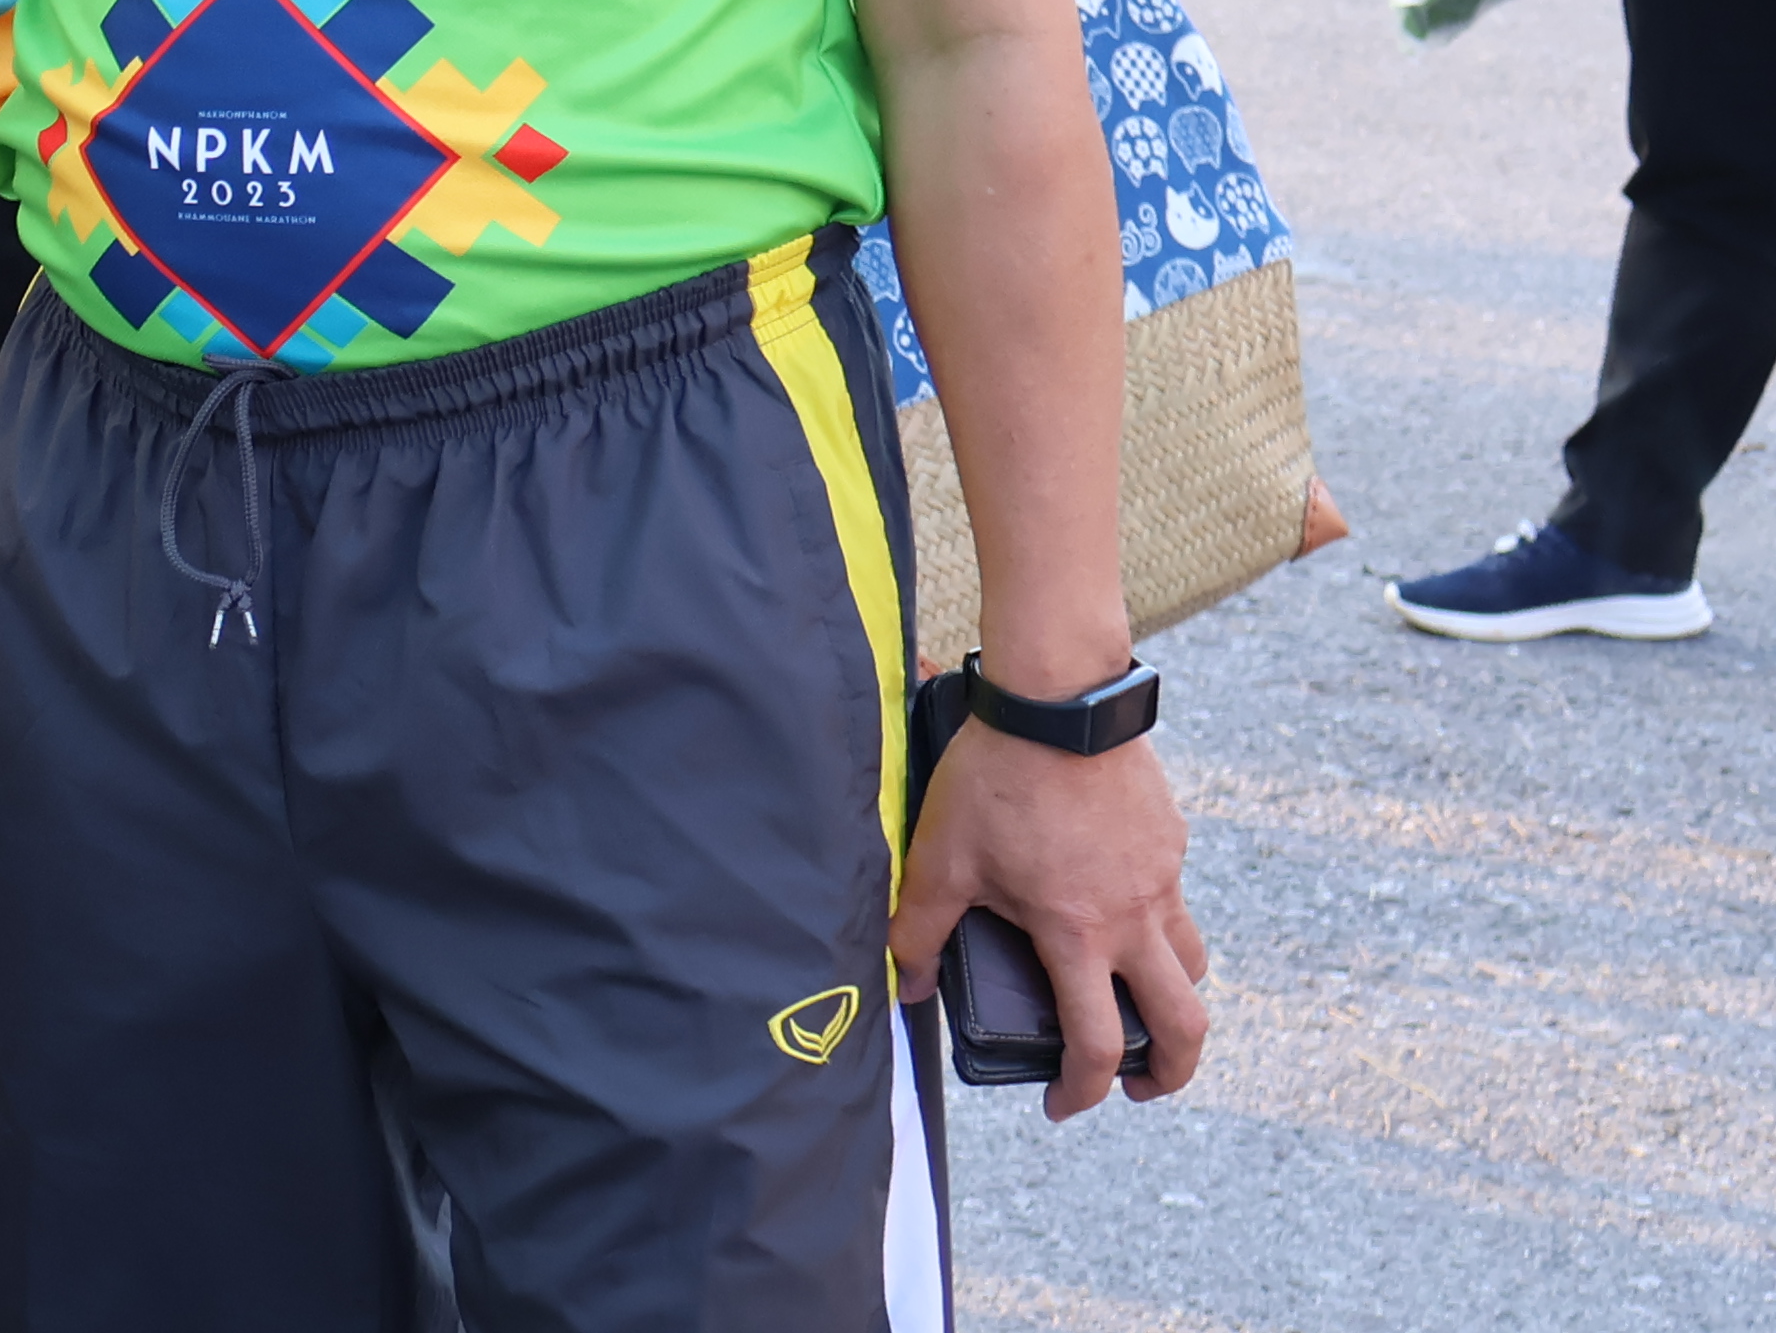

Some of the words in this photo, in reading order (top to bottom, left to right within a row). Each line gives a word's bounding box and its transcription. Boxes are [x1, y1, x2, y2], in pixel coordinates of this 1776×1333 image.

[148, 126, 335, 175] NPKM
[182, 179, 297, 208] 2023
[255, 215, 317, 225] MARATHON
